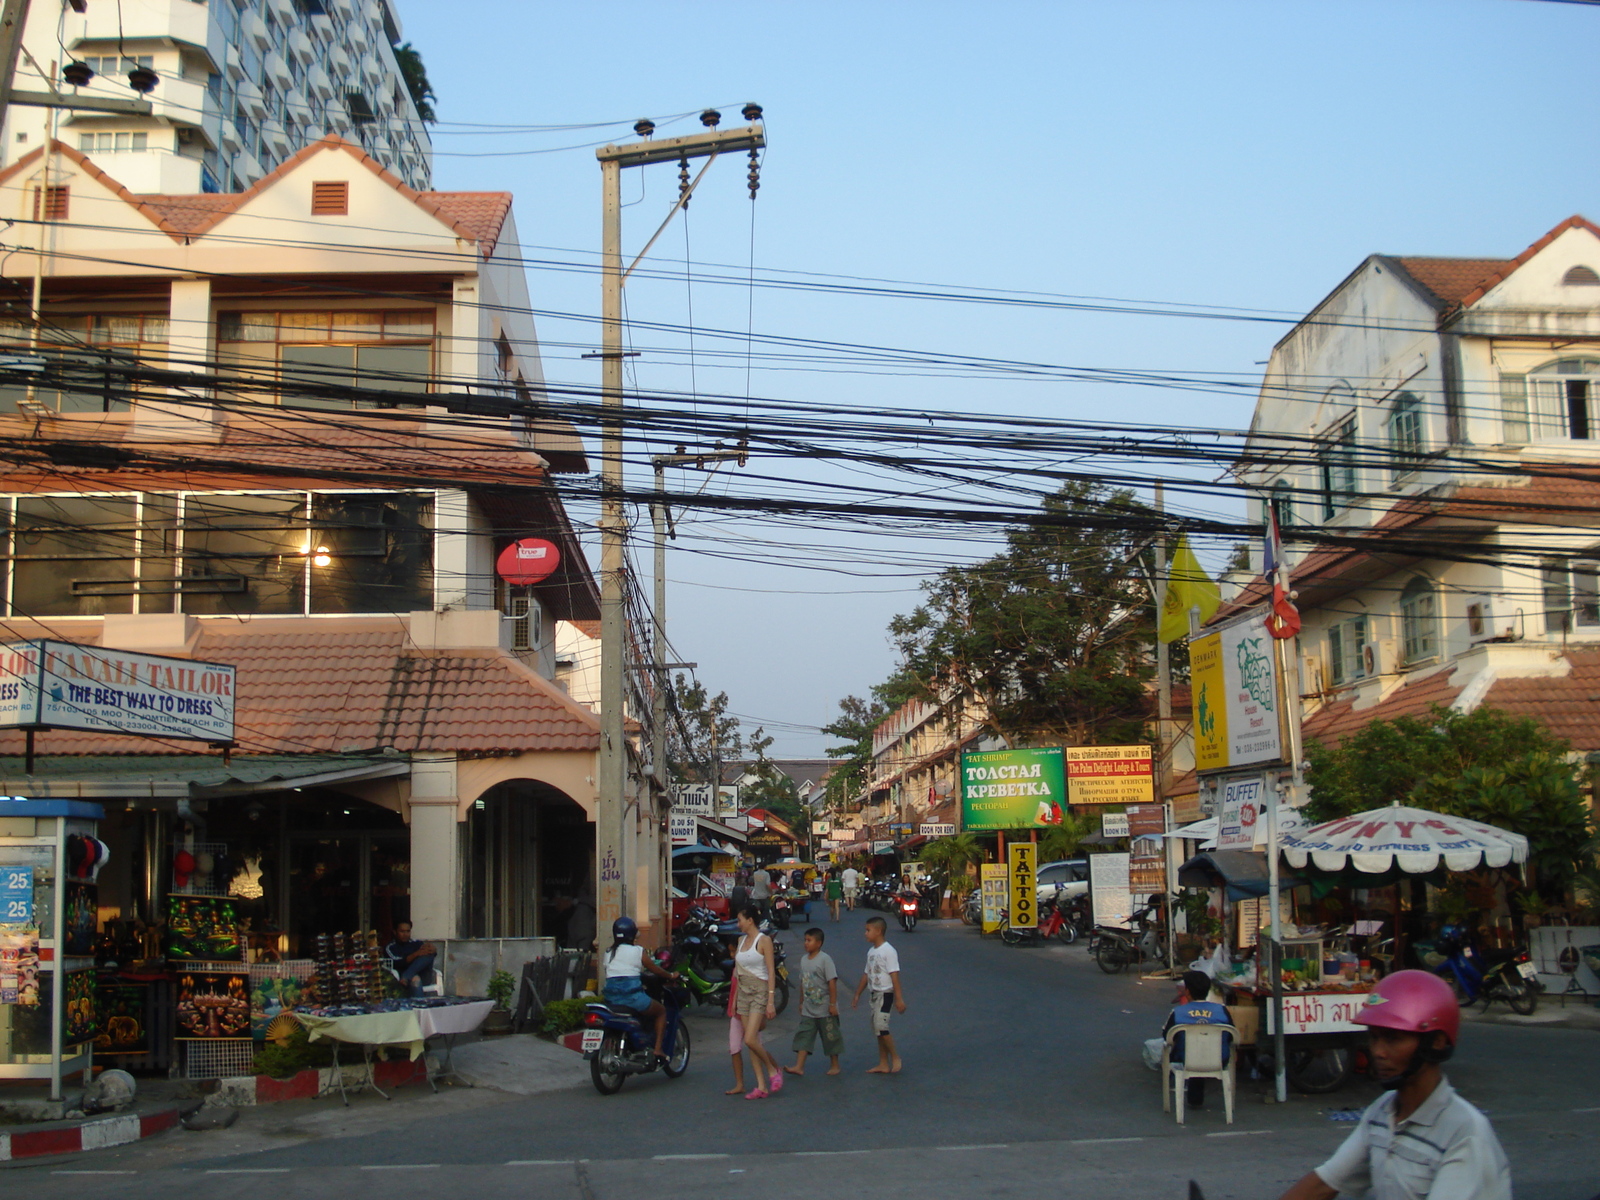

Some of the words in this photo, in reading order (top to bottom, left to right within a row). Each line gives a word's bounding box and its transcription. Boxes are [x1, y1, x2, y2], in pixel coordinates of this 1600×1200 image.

[1194, 650, 1217, 664] DENMARK
[46, 651, 138, 686] CANALI
[146, 662, 232, 696] TAILOR
[68, 684, 91, 704] THE
[94, 688, 124, 708] BEST
[126, 692, 156, 710] WAY
[159, 695, 174, 712] TO
[177, 698, 212, 716] DRESS
[1238, 692, 1250, 703] White
[101, 710, 122, 718] MOO
[140, 714, 178, 723] JOMTIEN
[1244, 706, 1257, 715] House
[84, 717, 103, 726] TEL.
[1250, 717, 1264, 728] Resort
[966, 764, 1042, 780] ТОЛСТАЯ
[1068, 762, 1080, 774] The
[1080, 762, 1093, 773] Palm
[1094, 762, 1112, 776] Delight
[1114, 761, 1130, 775] Lodge
[1135, 760, 1150, 772] Tours
[966, 782, 1052, 798] КРЕВЕТКА
[1226, 782, 1260, 802] BUFFET
[971, 802, 1008, 810] РЕСТОРАН
[671, 828, 694, 836] AUNDRY
[922, 826, 934, 834] ROOM
[934, 826, 942, 834] FOR
[944, 826, 954, 834] RENT
[1369, 843, 1431, 852] FITNESS
[9, 872, 28, 889] 25
[1015, 848, 1031, 924] TATTOO
[8, 900, 28, 918] 25
[1188, 1010, 1212, 1018] TAXI
